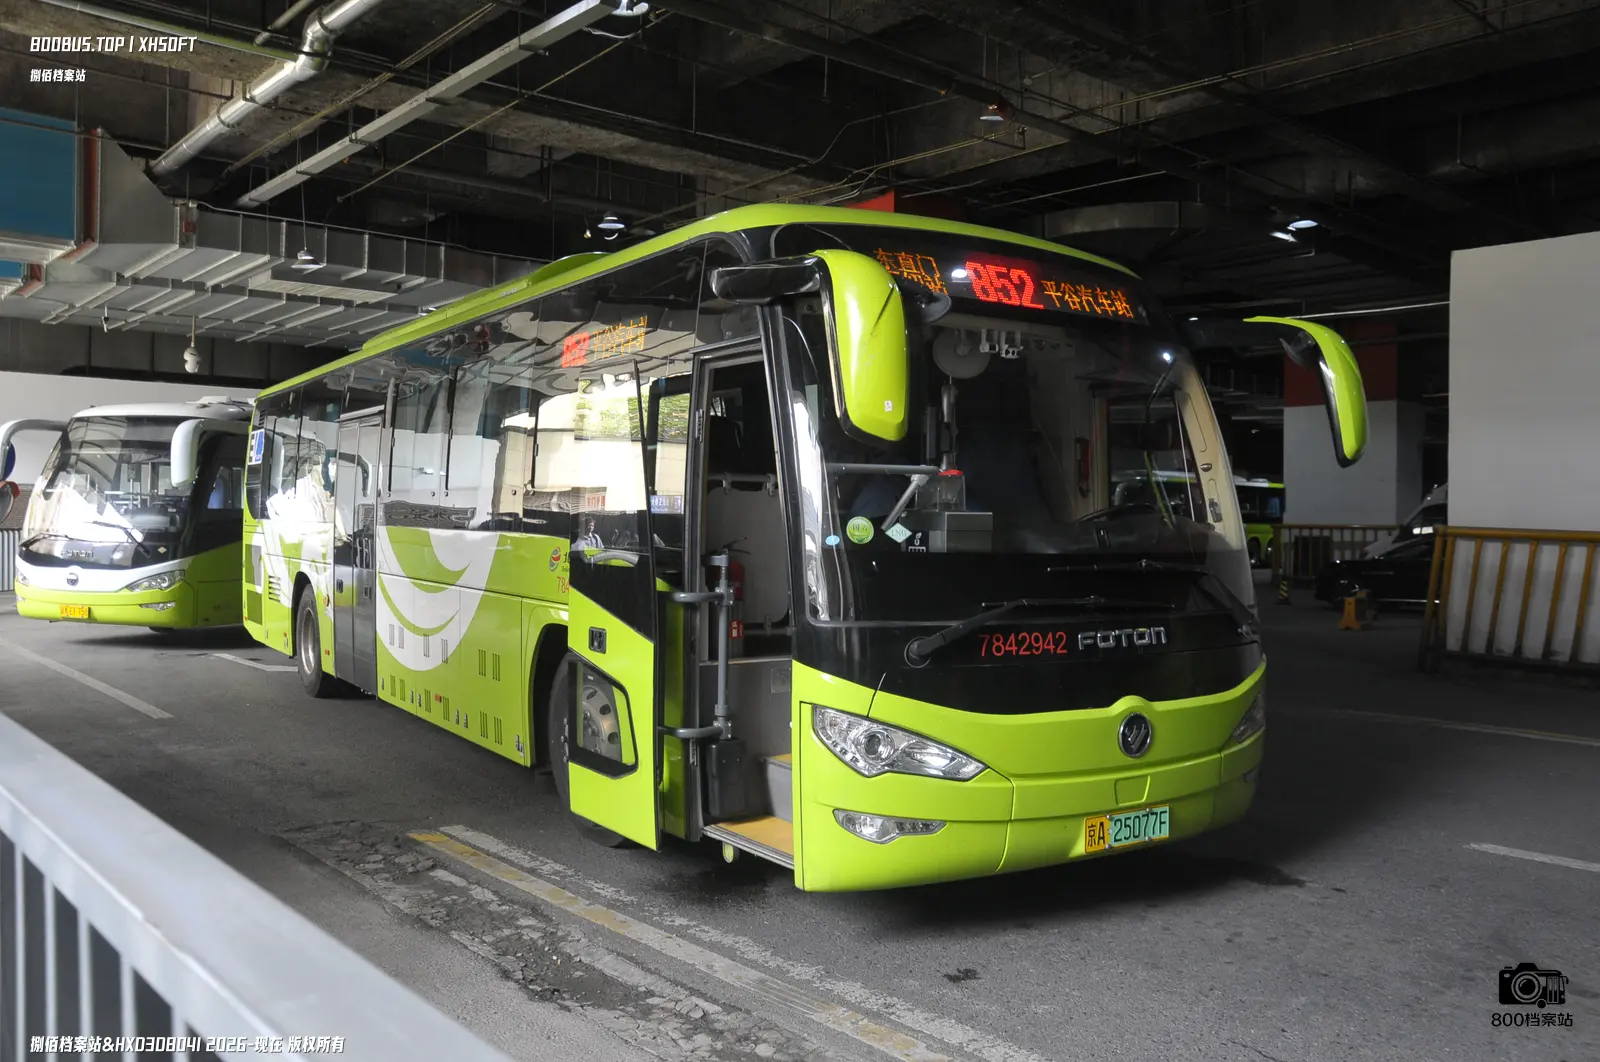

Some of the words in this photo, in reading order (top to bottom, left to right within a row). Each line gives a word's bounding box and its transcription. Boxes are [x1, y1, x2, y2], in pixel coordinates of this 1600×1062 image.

[964, 261, 1044, 309] 852
[1040, 279, 1134, 318] 平谷汽车站
[979, 631, 1068, 657] 7842942
[1077, 626, 1167, 651] FOTON
